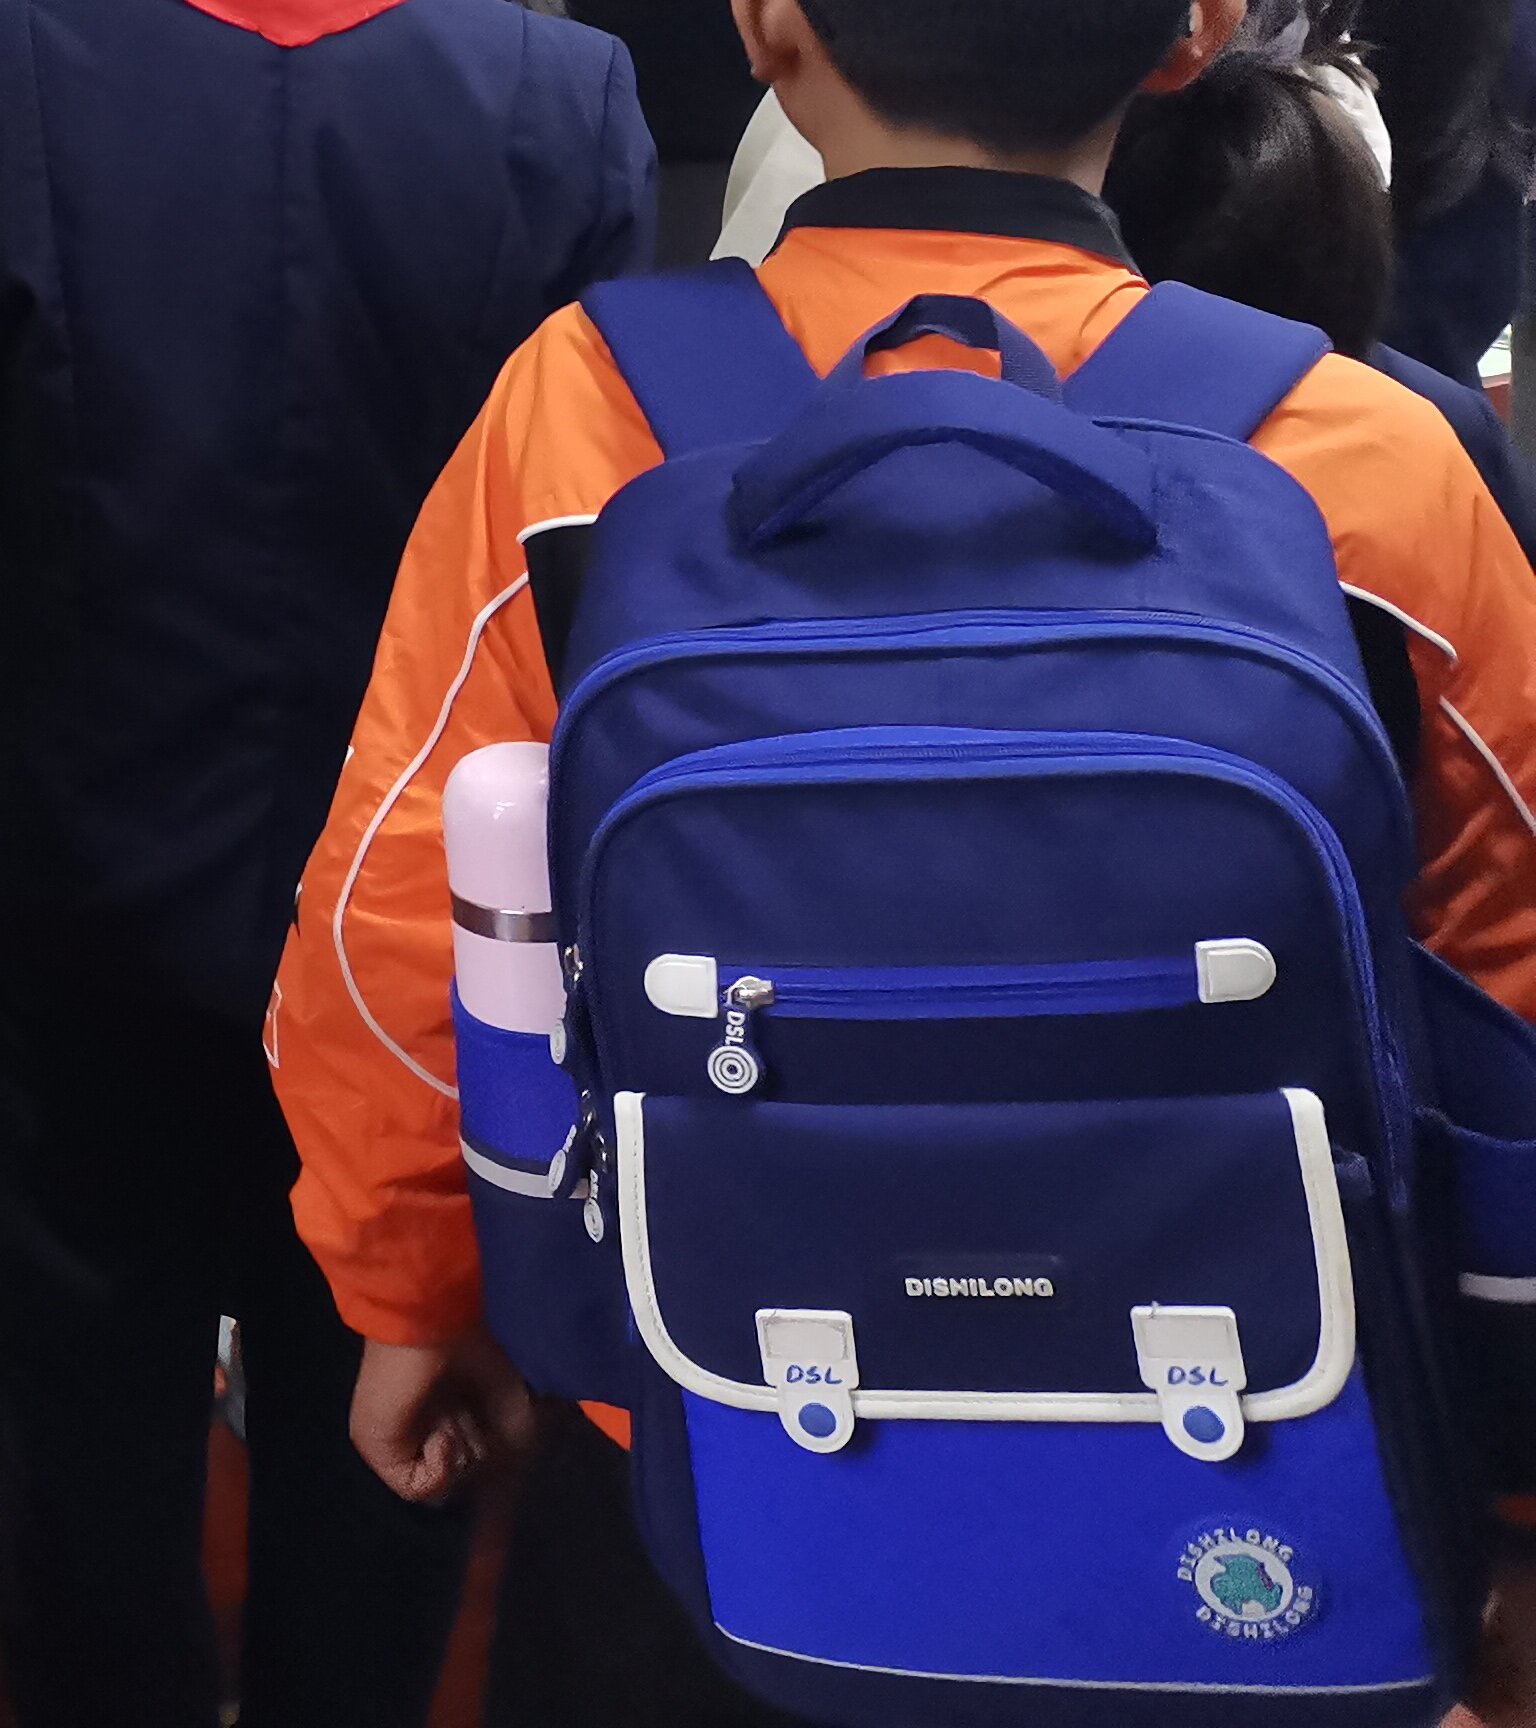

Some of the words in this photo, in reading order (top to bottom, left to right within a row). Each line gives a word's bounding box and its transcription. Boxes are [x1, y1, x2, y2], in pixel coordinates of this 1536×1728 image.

[725, 1011, 745, 1046] DSL
[786, 1364, 843, 1385] DSL
[1168, 1365, 1230, 1386] DSL
